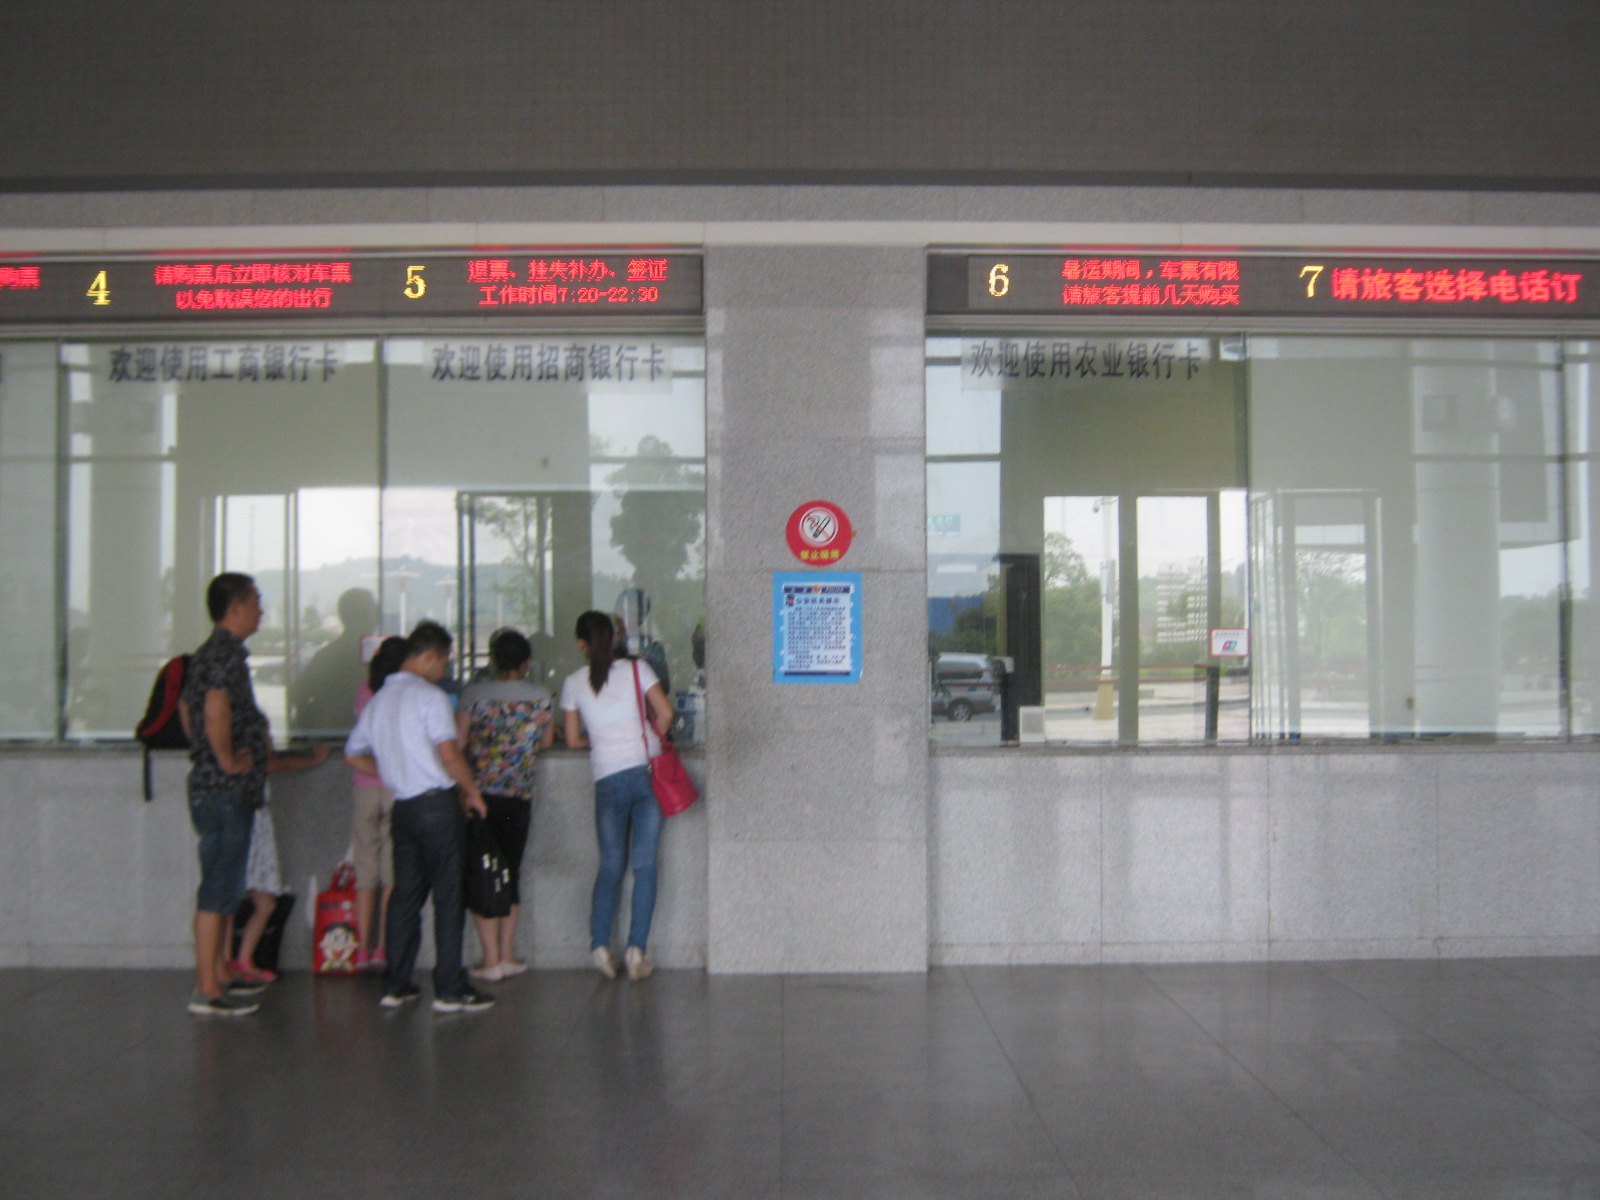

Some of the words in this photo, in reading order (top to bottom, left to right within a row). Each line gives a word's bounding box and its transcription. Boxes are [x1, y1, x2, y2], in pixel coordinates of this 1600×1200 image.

[154, 263, 352, 285] 请购票后立即核对车票
[403, 265, 427, 299] 5
[467, 259, 668, 283] 退票、挂失补办、签证
[988, 263, 1010, 297] 6
[1062, 259, 1240, 281] 暑运期间，车票有限
[1298, 265, 1324, 298] 7
[1331, 267, 1583, 304] 请旅客选择电话订
[86, 270, 111, 305] 4
[175, 287, 332, 309] 以免耽误您的出行
[1062, 283, 1240, 306] 请旅客提前几天购买
[109, 344, 339, 383] 欢迎使用工商银行卡
[432, 342, 666, 382] 欢迎使用招商银行卡
[970, 341, 1203, 380] 欢迎使用农业银行卡
